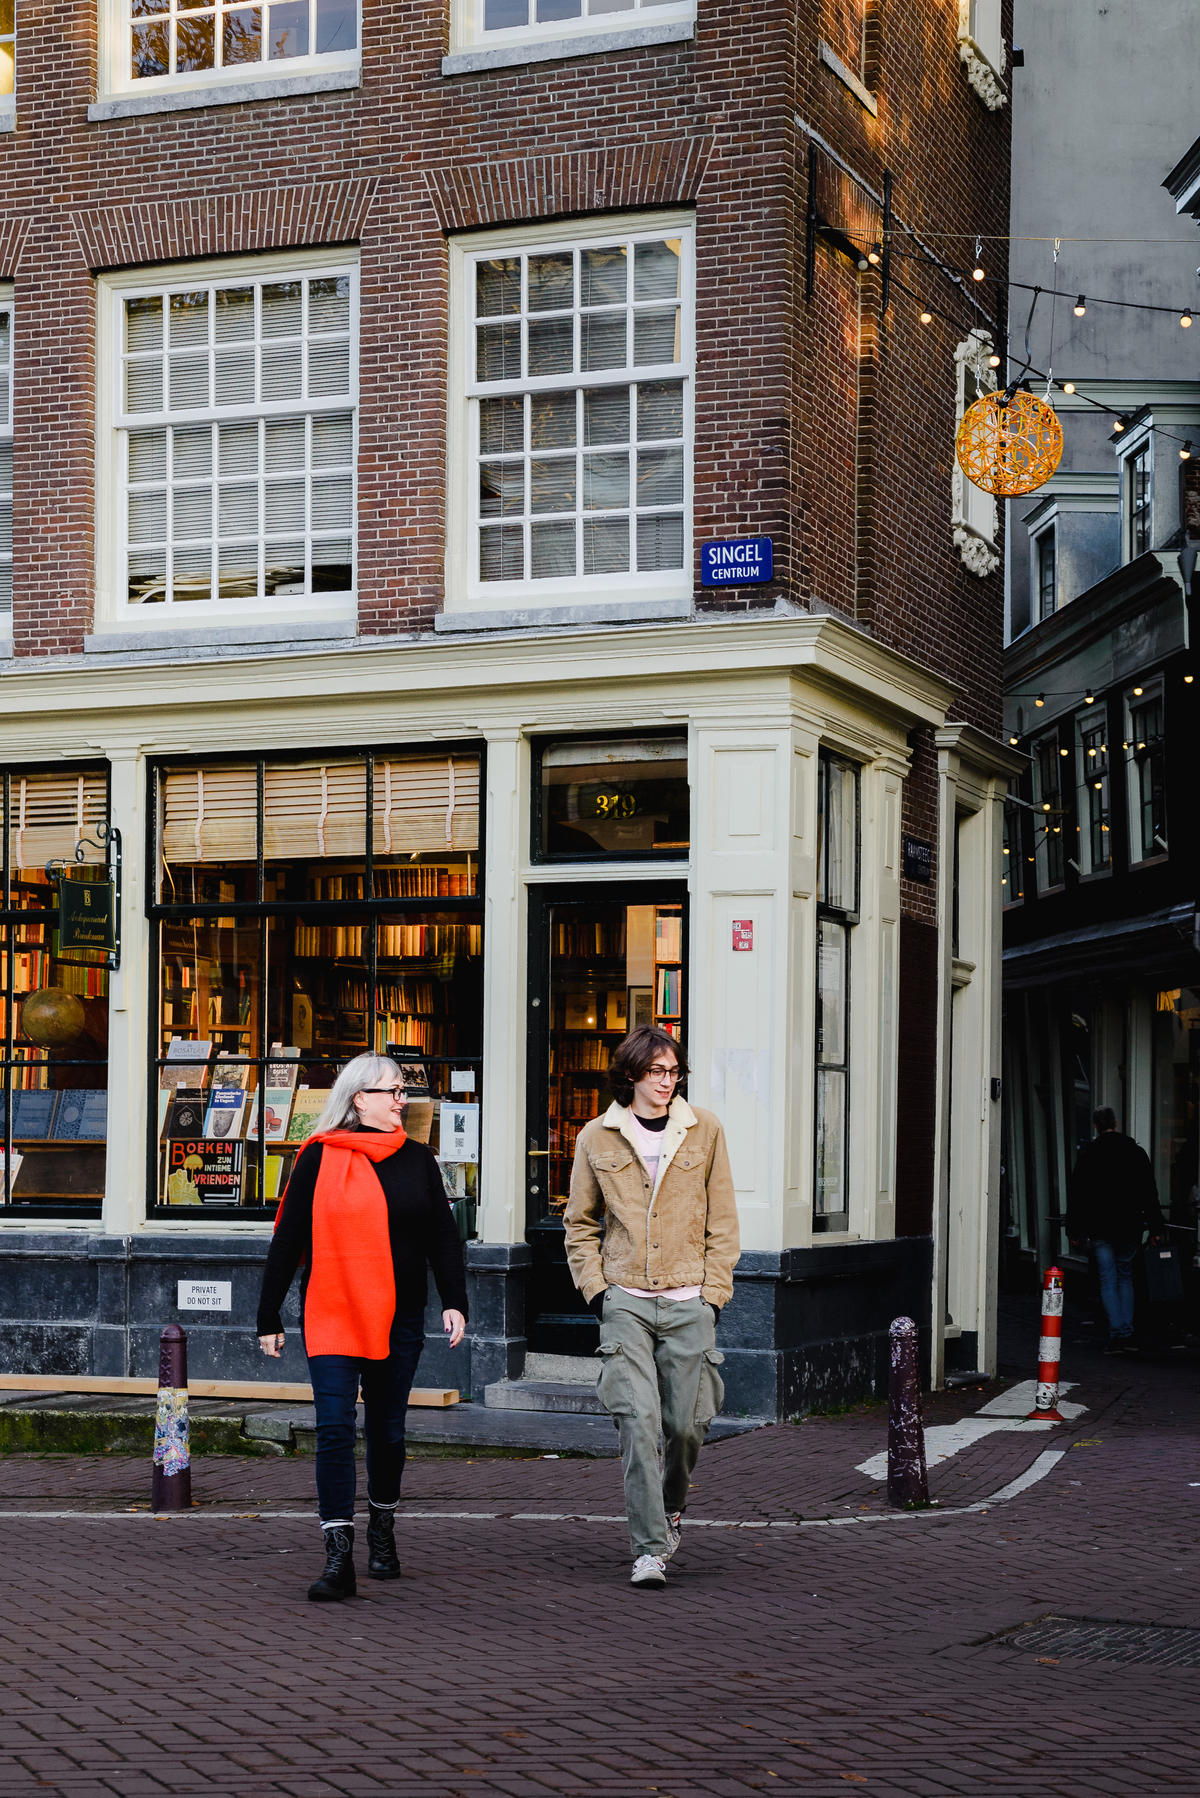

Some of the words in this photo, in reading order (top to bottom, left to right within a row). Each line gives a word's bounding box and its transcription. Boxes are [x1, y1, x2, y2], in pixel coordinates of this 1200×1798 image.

[709, 544, 763, 565] SINGEL
[711, 566, 760, 579] CENTRUM
[596, 794, 636, 819] 319
[172, 1143, 233, 1165] BOEKEN
[204, 1164, 231, 1172] INTIEME
[194, 1174, 240, 1185] VRIENDEN
[191, 1286, 217, 1294] PRIVATE
[187, 1297, 196, 1305] DO
[197, 1297, 210, 1305] NOT
